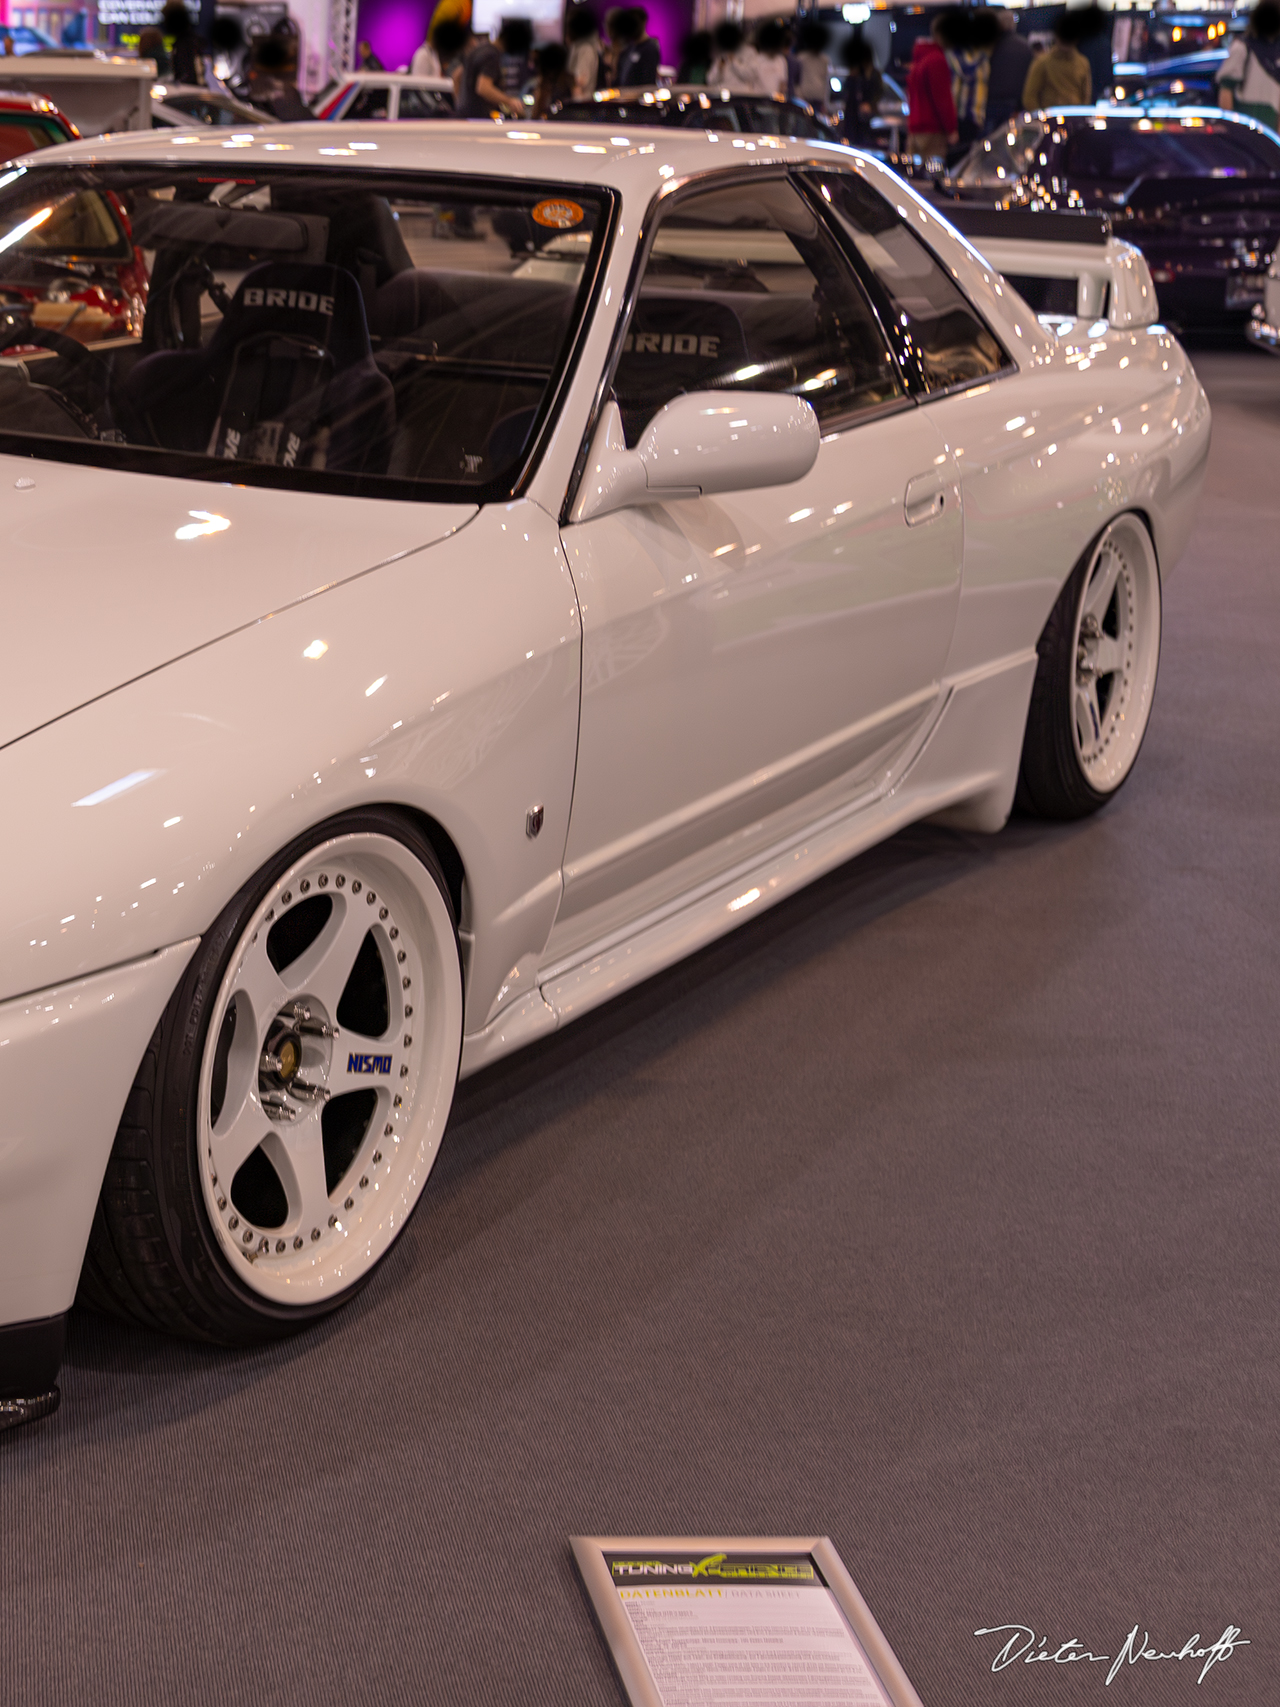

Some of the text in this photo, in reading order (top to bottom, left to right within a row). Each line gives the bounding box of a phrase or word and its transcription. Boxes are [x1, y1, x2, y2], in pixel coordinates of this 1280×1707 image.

[243, 287, 335, 316] BRIDE
[346, 1052, 393, 1075] NISMO
[619, 1588, 723, 1600] DATENBLATT
